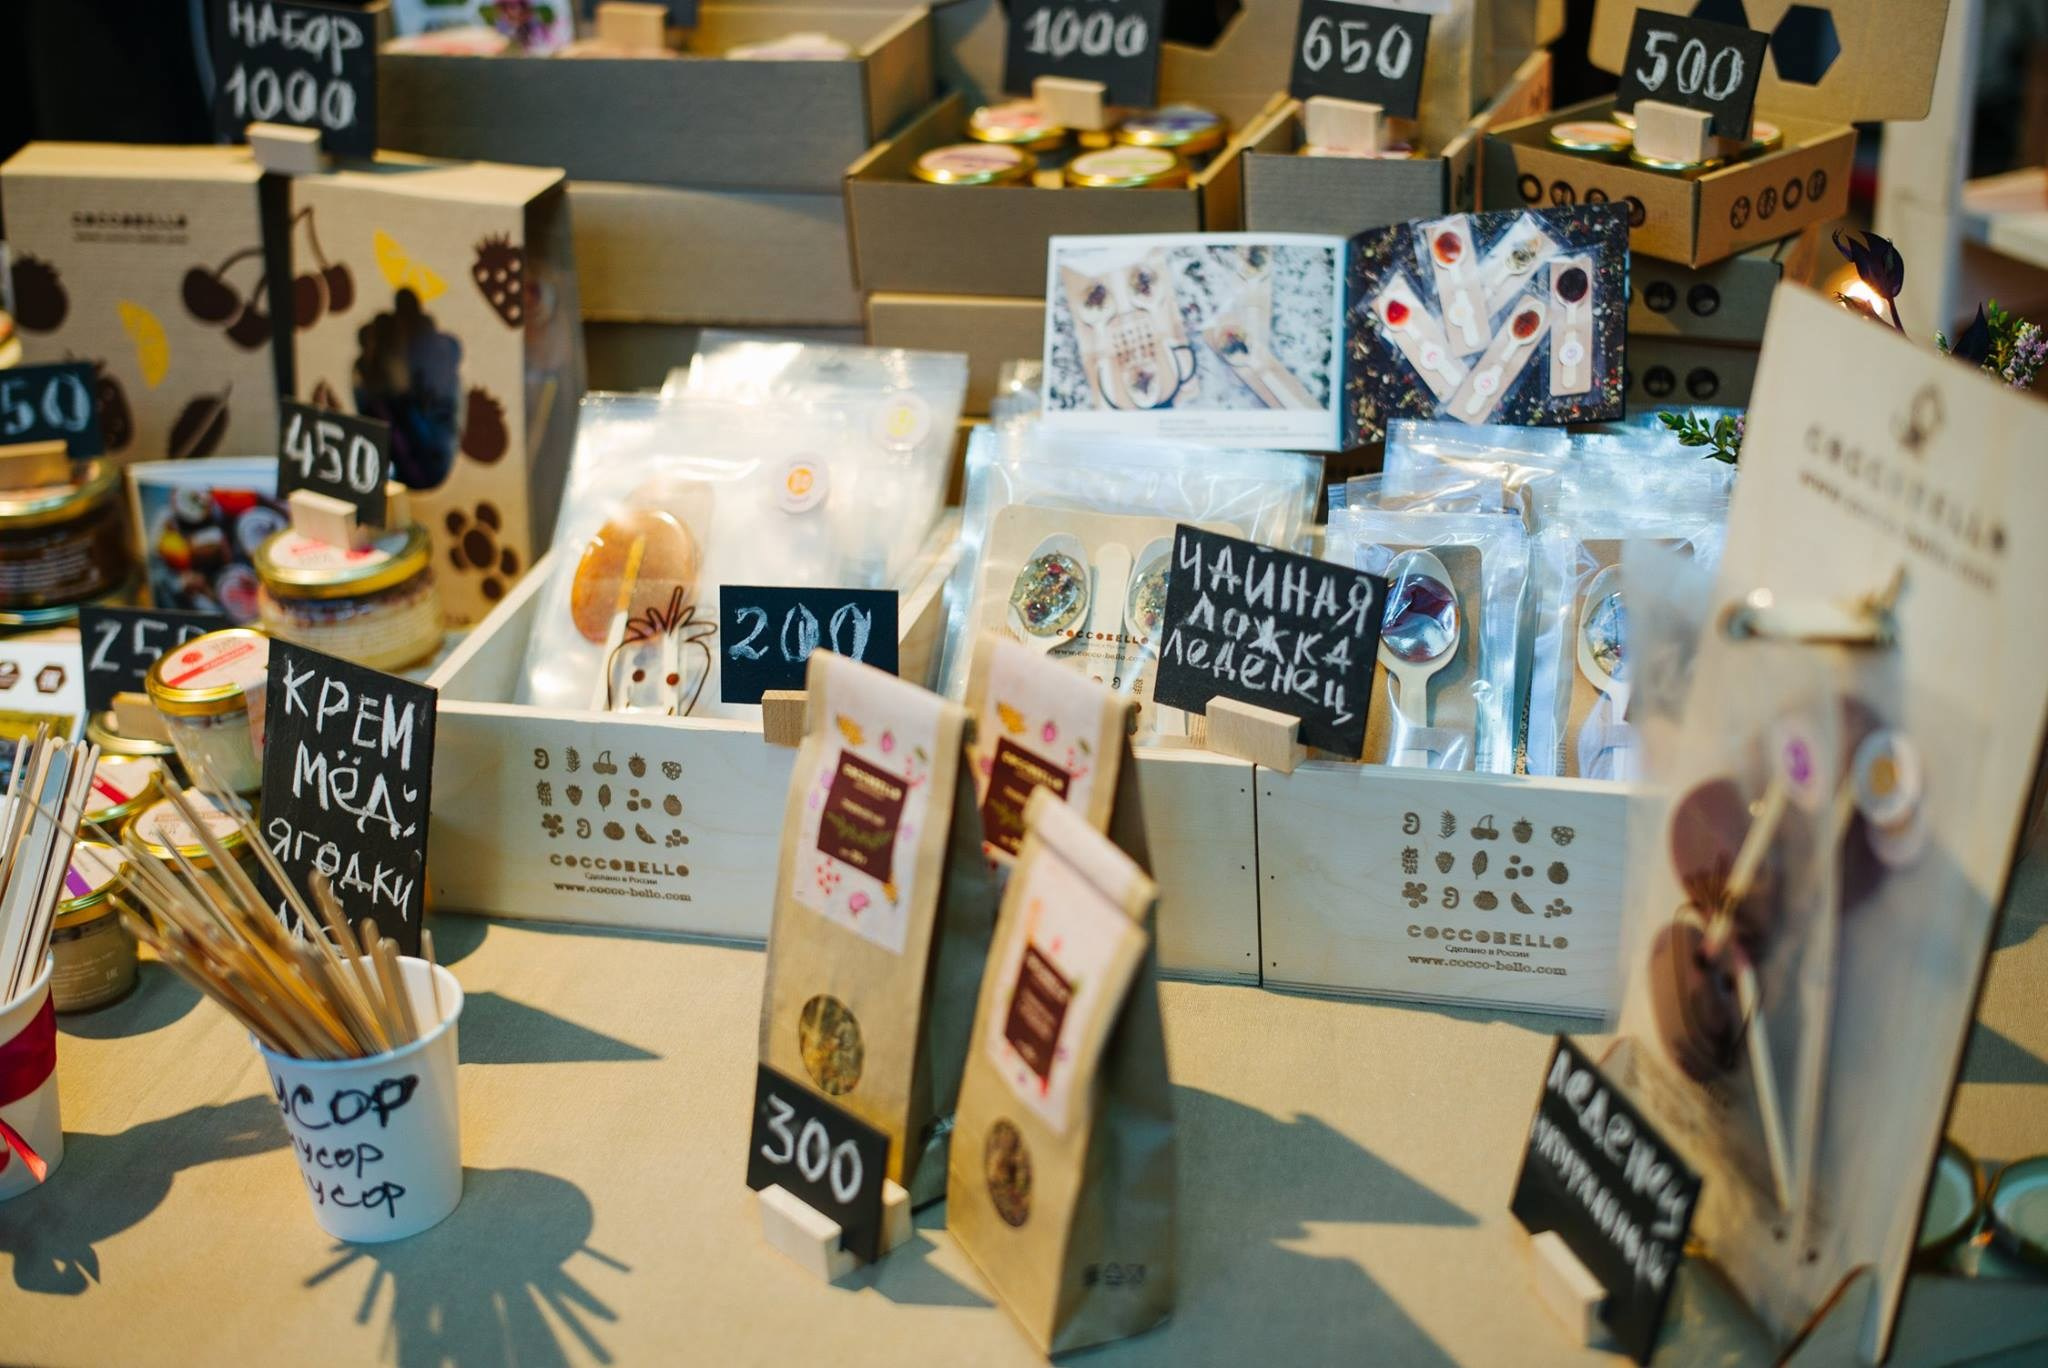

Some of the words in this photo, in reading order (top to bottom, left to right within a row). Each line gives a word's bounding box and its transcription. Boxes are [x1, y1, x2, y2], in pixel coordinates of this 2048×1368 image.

[1023, 6, 1149, 58] 1000
[1302, 14, 1413, 80] 650
[1635, 28, 1745, 101] 500
[225, 64, 357, 131] 1000
[285, 413, 381, 495] 450
[1179, 534, 1374, 639] ЧАЙНАЯ
[727, 601, 872, 665] 200
[1055, 628, 1150, 645] COCCOBELLO
[1187, 591, 1353, 675] ЛОЖКА
[282, 658, 416, 771] КРЕМ
[550, 853, 690, 878] COCCOBELLO
[553, 881, 692, 902] www.cocco-bello.com
[1406, 924, 1569, 949] COCCOBELLO
[1407, 954, 1568, 976] www.cocco-bello.com
[760, 1092, 864, 1205] 300
